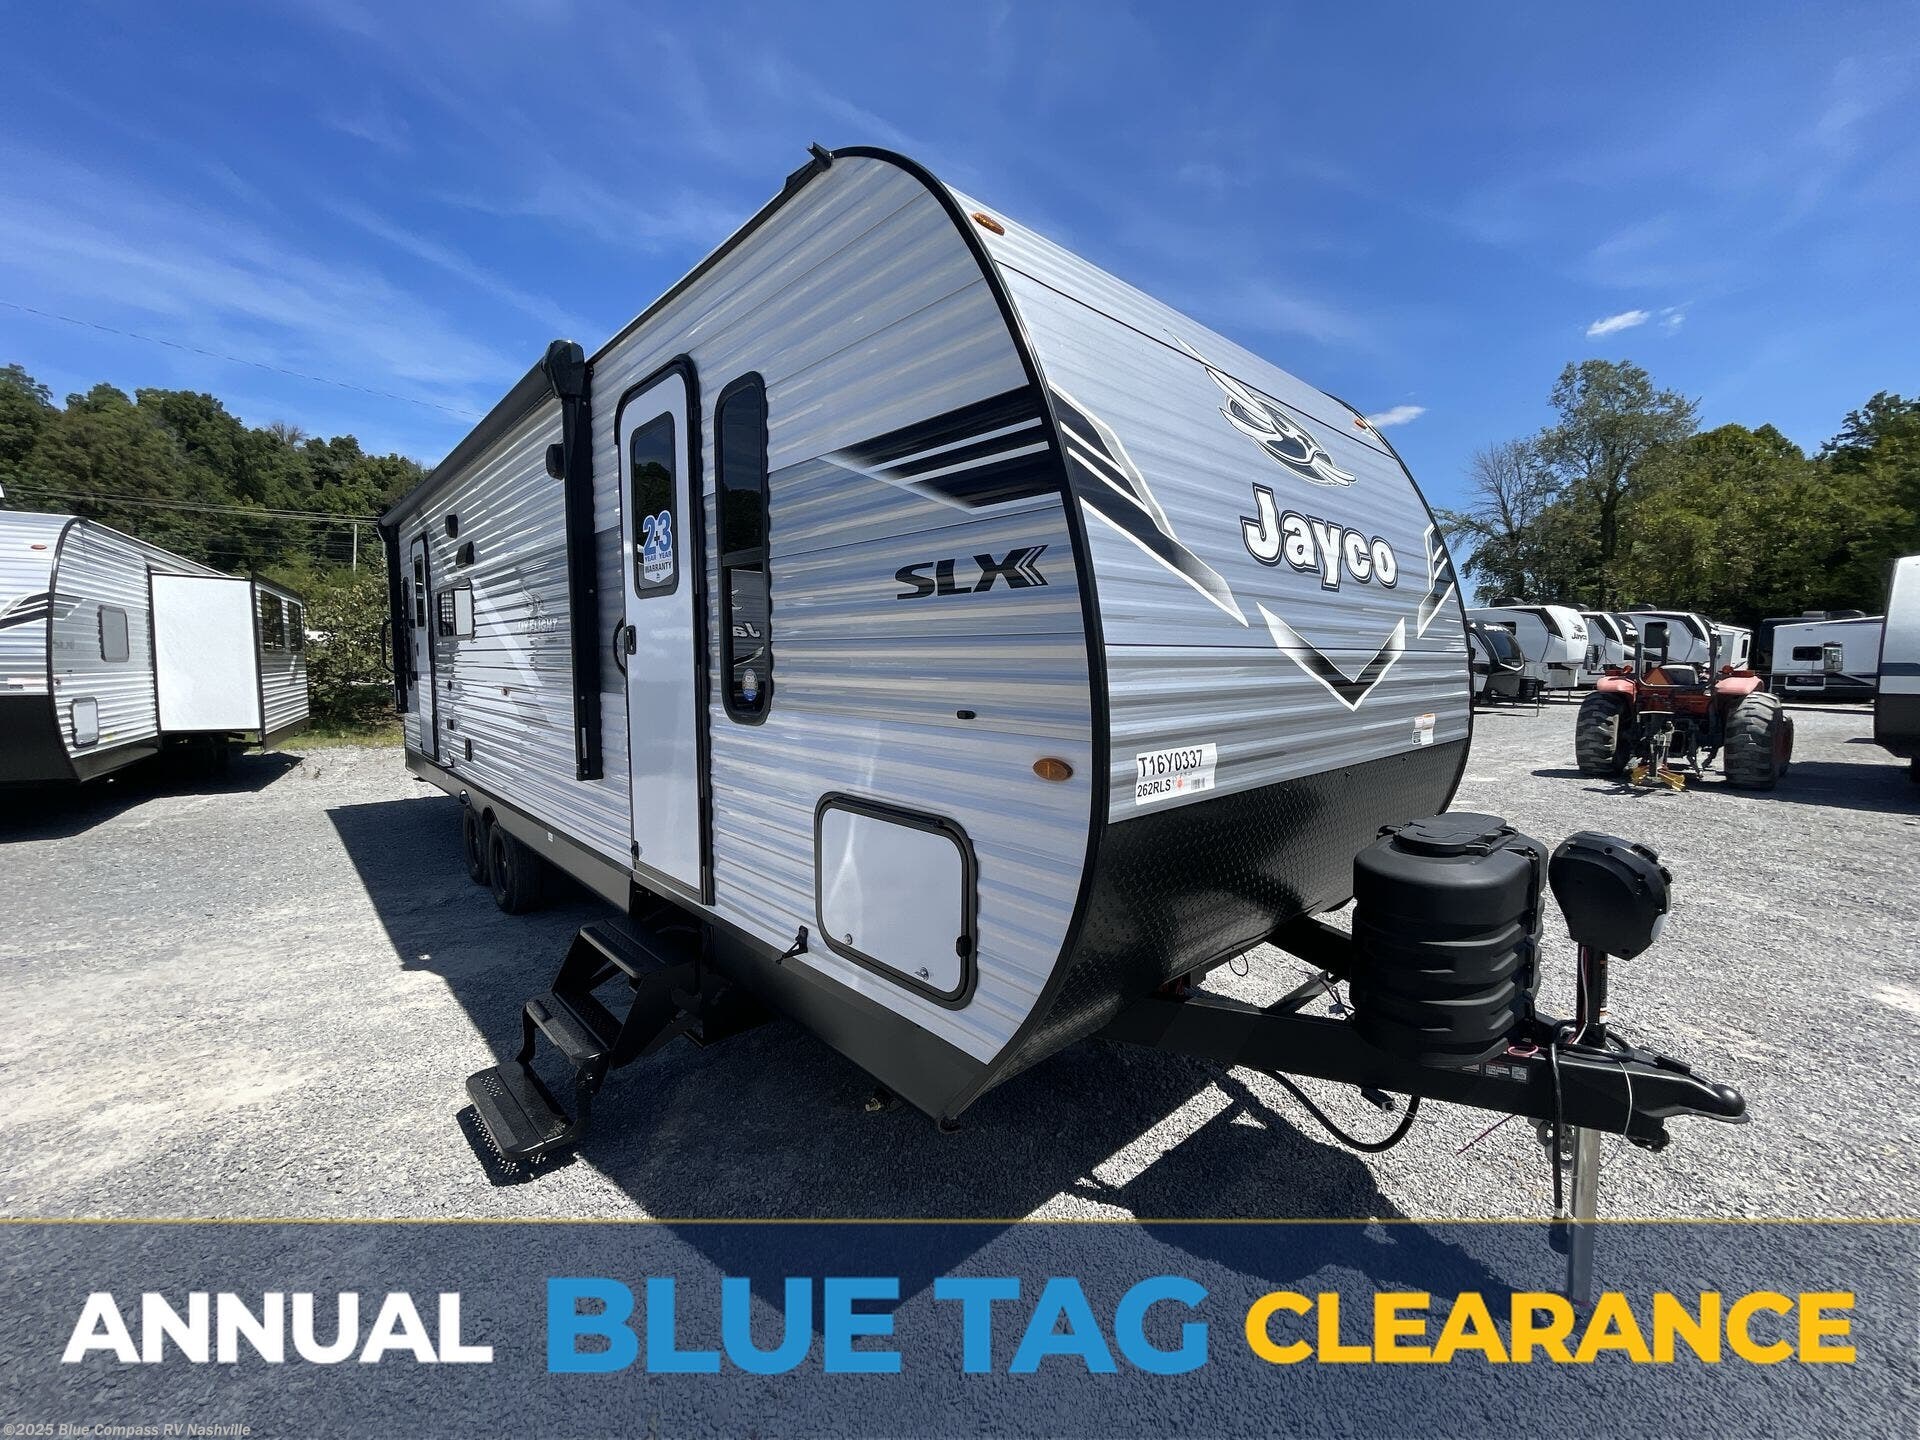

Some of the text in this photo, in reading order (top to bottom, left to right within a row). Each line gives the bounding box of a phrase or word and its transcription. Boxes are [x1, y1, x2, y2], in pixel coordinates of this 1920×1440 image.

[1240, 483, 1398, 592] Jayco
[645, 562, 672, 573] WARRANTY
[895, 545, 1048, 600] SLX
[1138, 749, 1203, 777] T16Y0337
[1137, 779, 1171, 797] 262RLS
